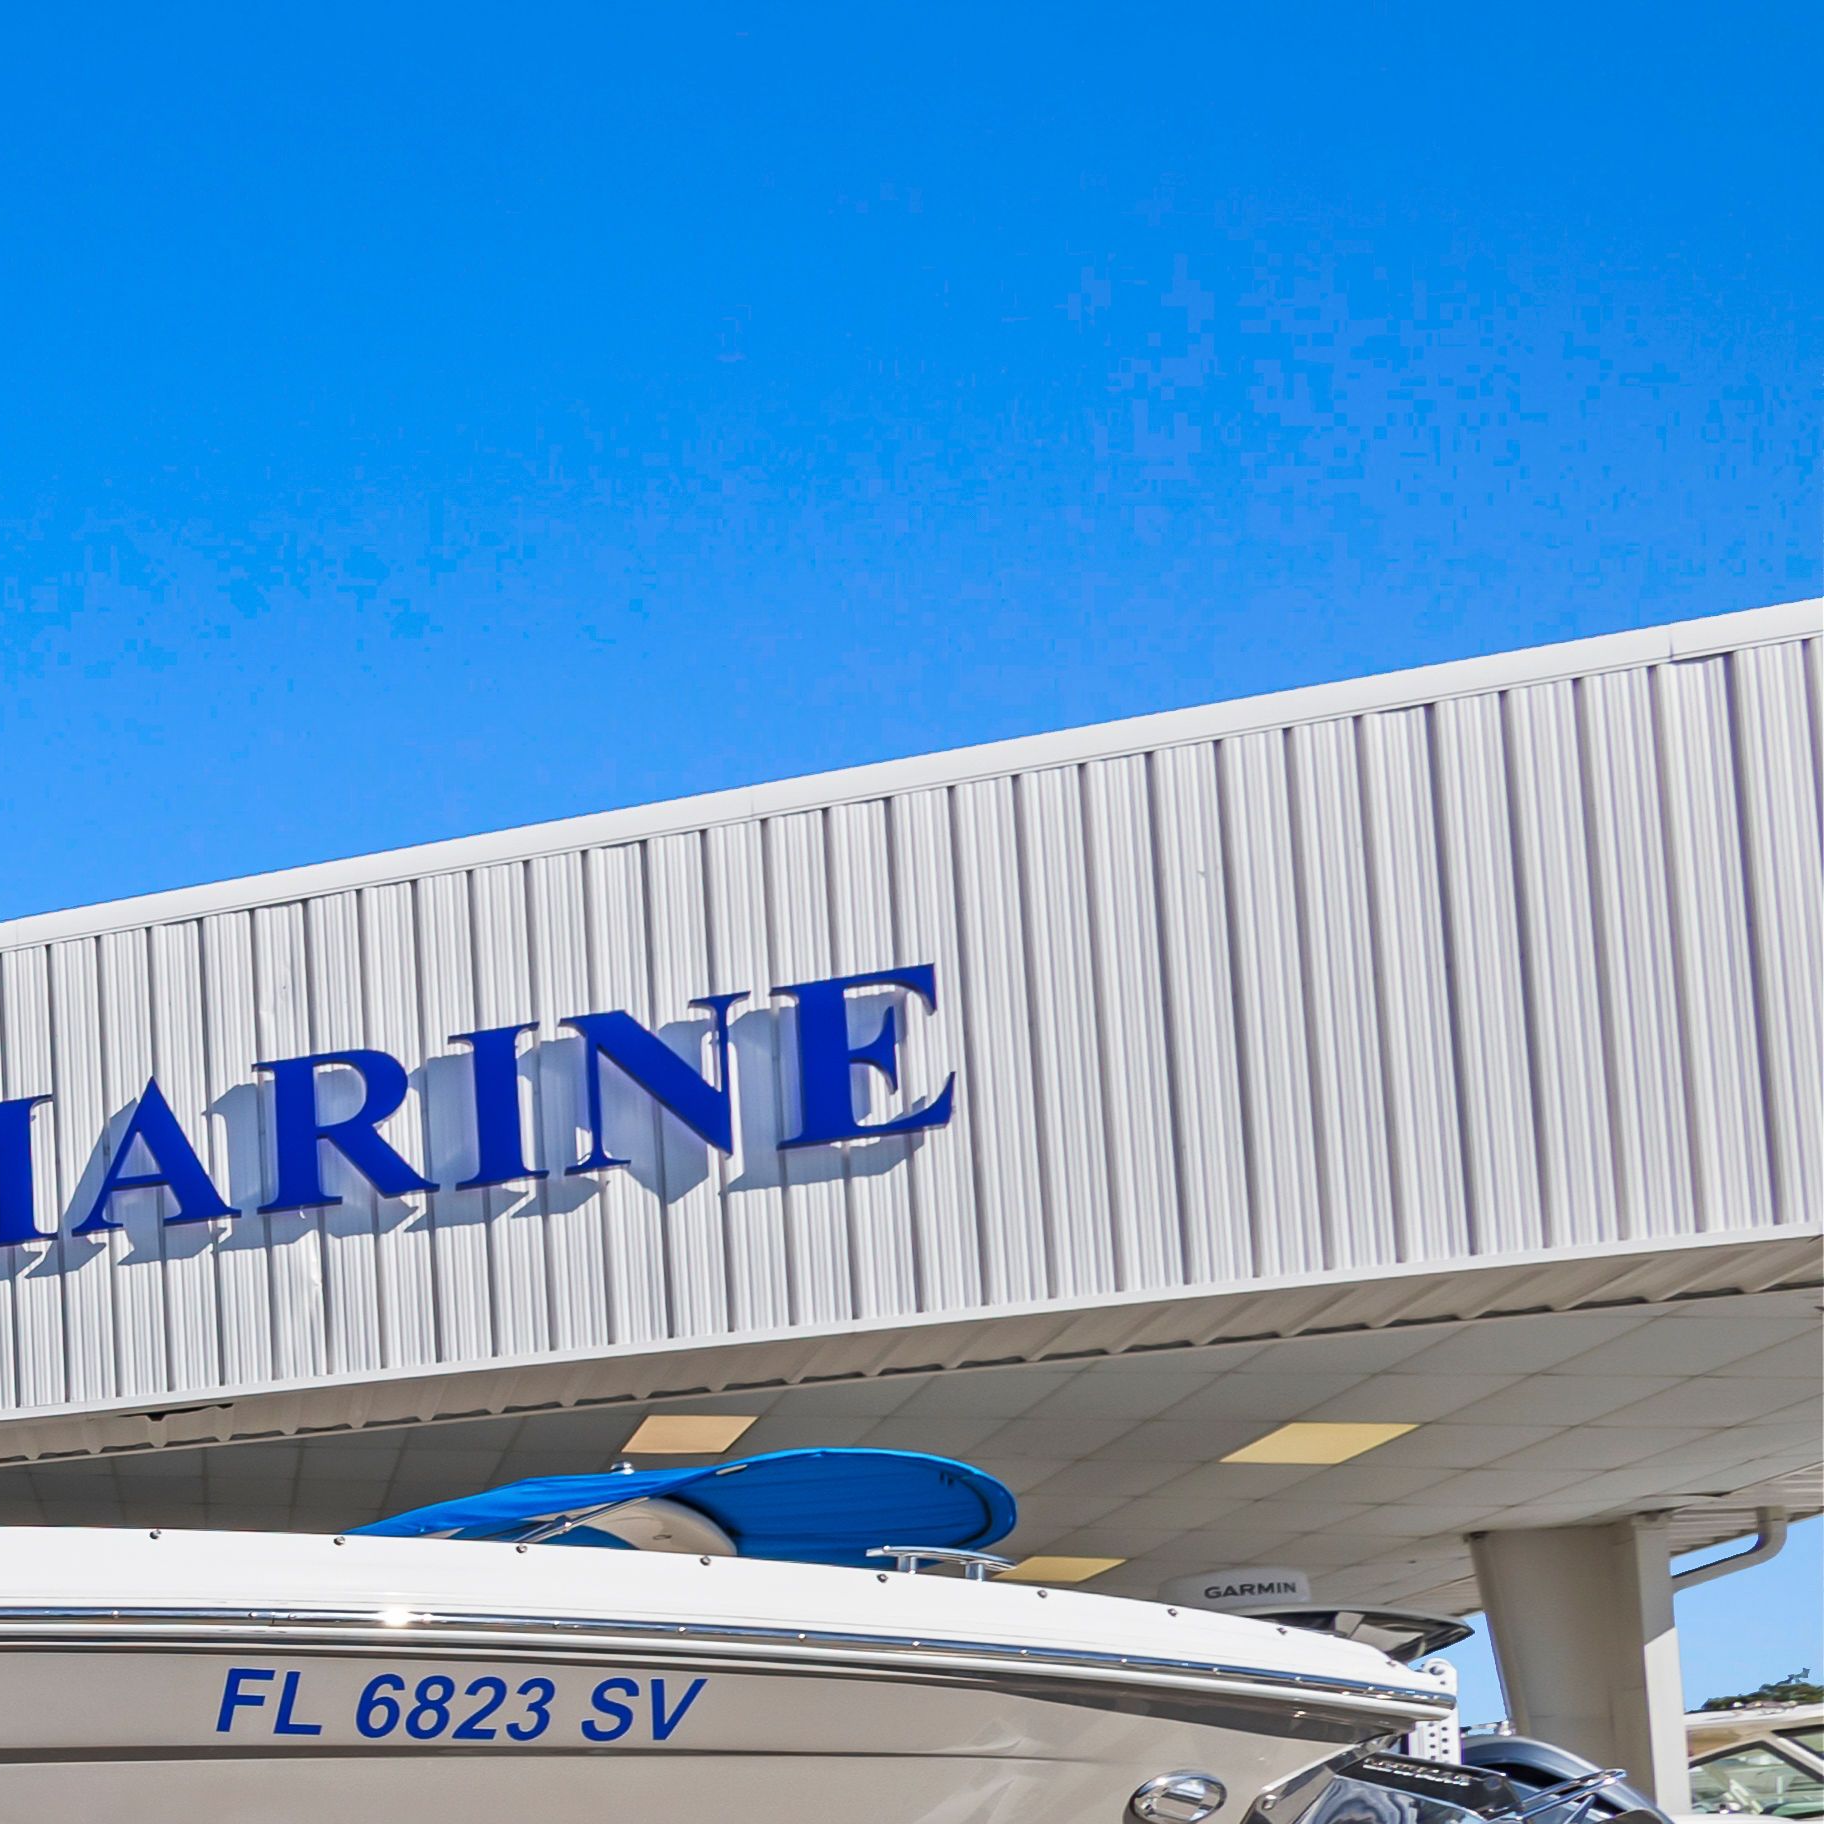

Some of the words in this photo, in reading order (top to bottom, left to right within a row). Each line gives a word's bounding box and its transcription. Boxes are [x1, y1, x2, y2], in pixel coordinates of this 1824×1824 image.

[1204, 1582, 1297, 1599] GARMIN
[216, 1668, 322, 1736] FL
[355, 1673, 556, 1741] 6823
[581, 1677, 709, 1742] SV
